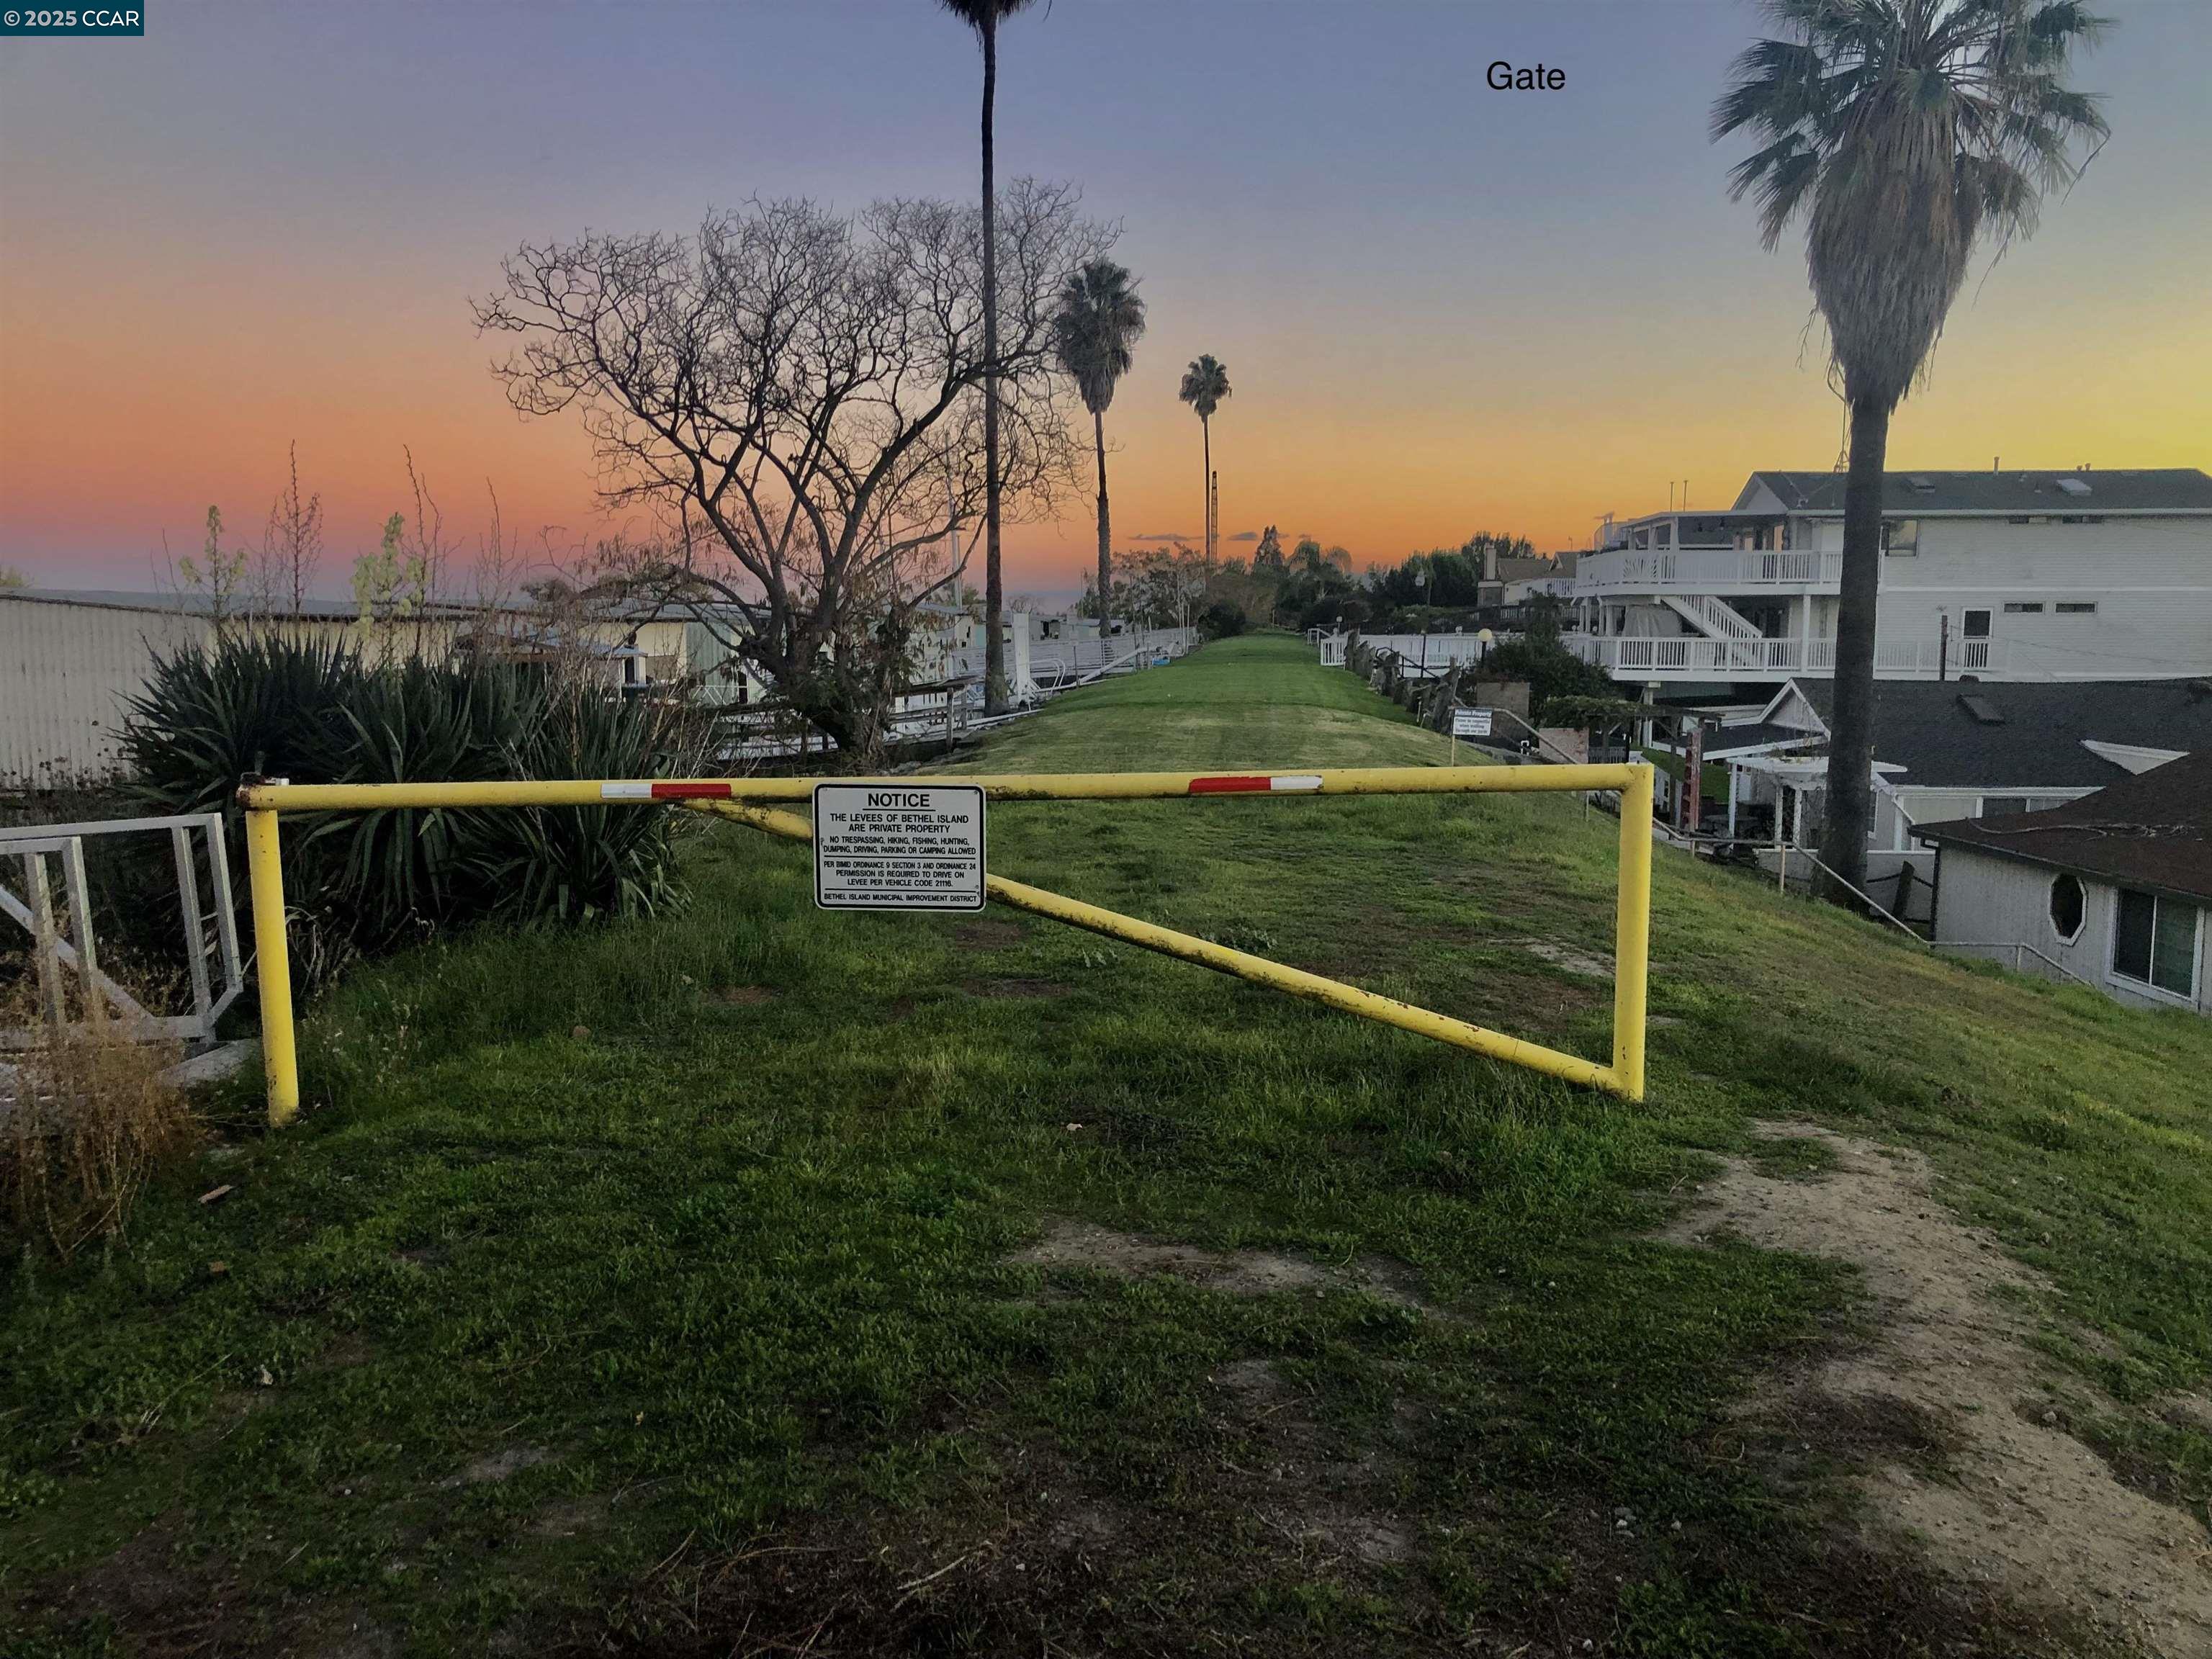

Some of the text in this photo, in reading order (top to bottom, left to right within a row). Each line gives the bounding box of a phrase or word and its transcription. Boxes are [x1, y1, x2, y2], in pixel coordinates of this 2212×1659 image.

[868, 793, 930, 806] NOTICE
[850, 814, 883, 822] LEVEES
[886, 814, 898, 822] OF
[902, 814, 934, 823] BETHEL
[938, 815, 968, 824] ISLAND
[906, 824, 950, 833] PROPERTY
[842, 836, 885, 845] TRESPASSING,
